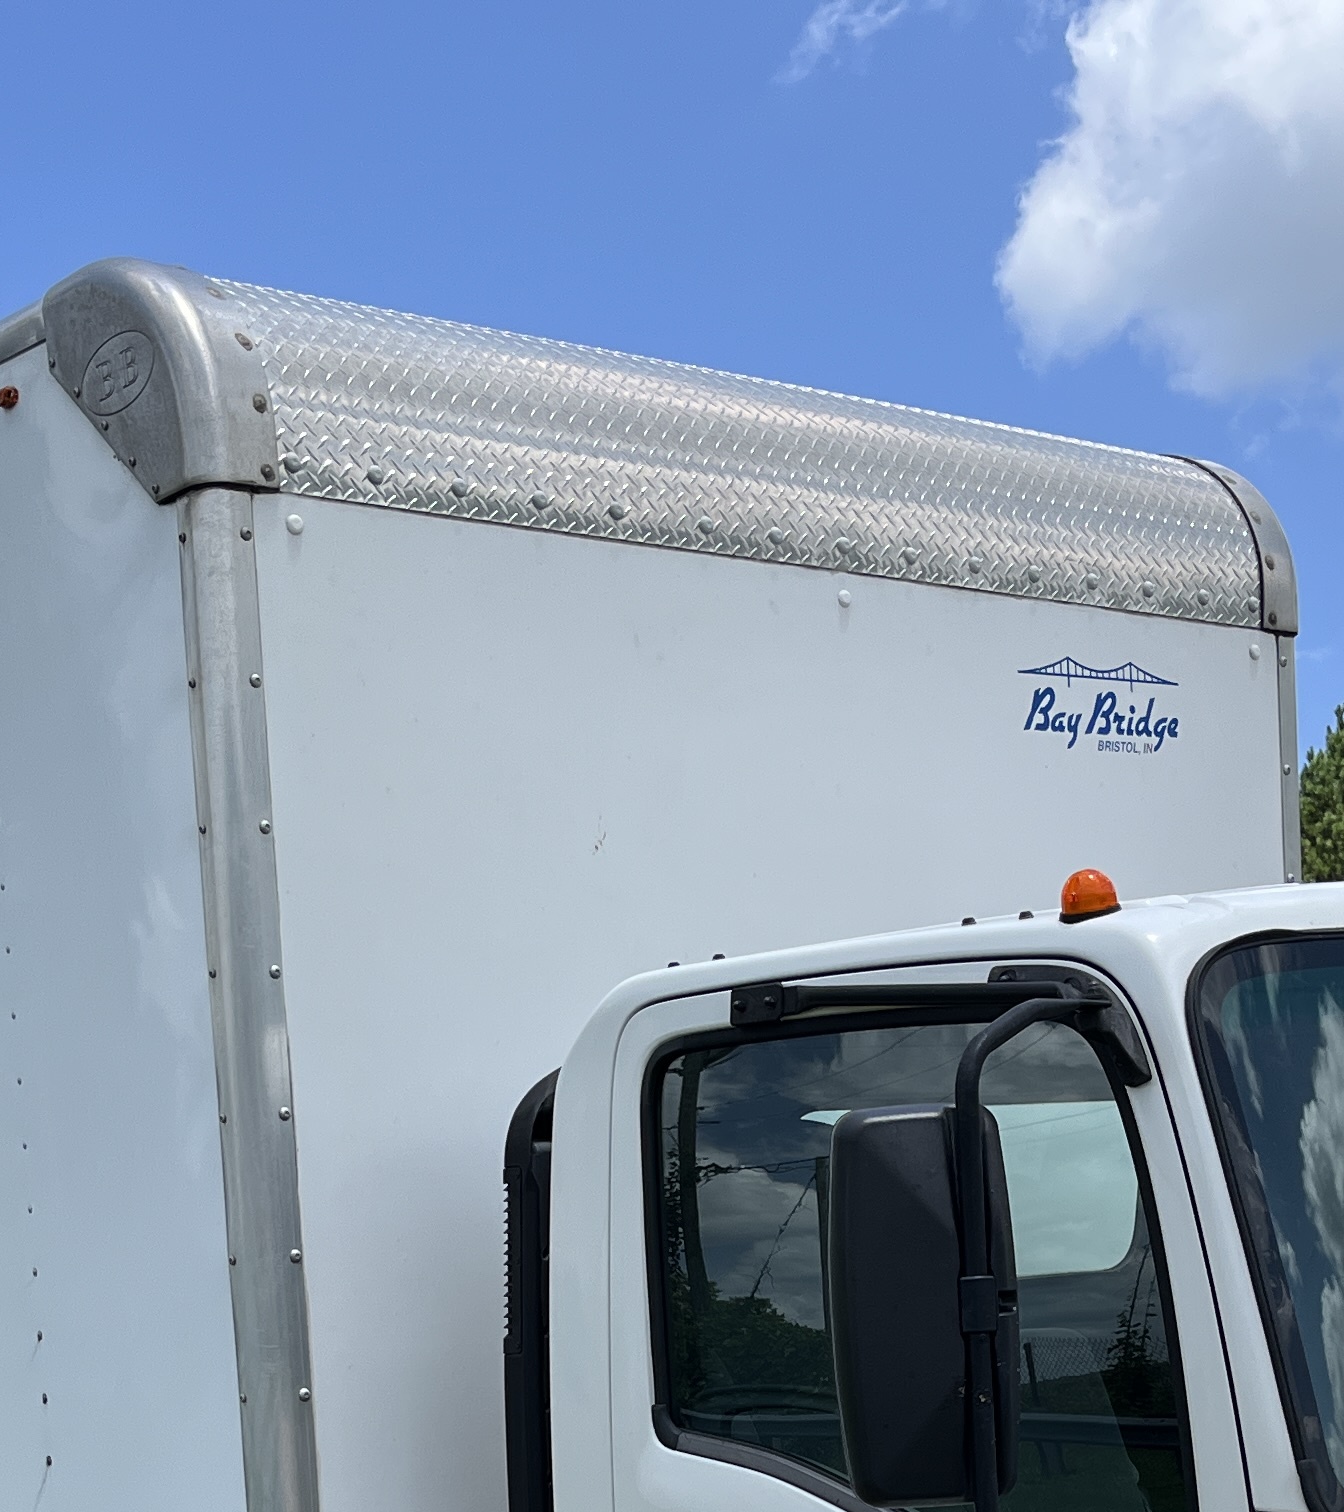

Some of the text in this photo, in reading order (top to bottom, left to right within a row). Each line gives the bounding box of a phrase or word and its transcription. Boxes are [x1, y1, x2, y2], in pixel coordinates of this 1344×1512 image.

[1024, 686, 1179, 752] Bay Bridge
[1097, 740, 1141, 754] BRISTOL,
